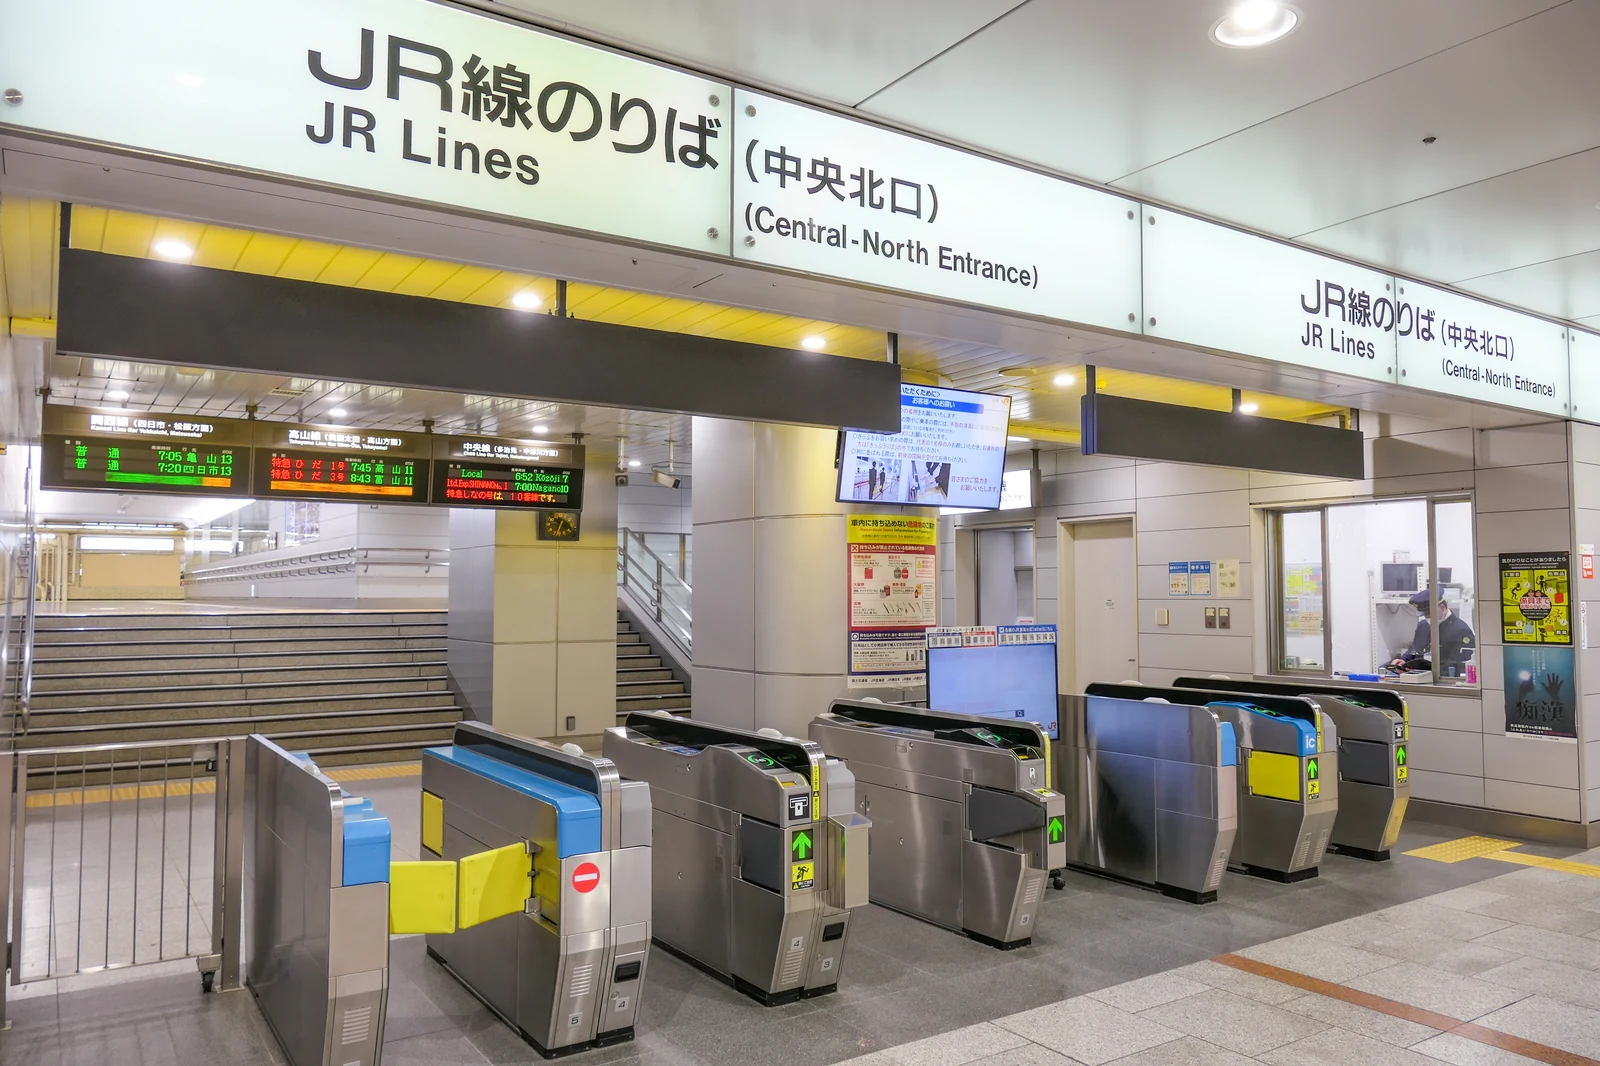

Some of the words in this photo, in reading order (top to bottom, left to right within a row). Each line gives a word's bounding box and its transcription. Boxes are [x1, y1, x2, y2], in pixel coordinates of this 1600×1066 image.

[308, 27, 723, 170] JR線のりば
[306, 101, 377, 153] JR
[402, 118, 540, 186] Lines
[745, 139, 938, 224] (中央北口)
[745, 202, 929, 266] (Central-North
[939, 245, 1038, 290] Entrance)
[1301, 279, 1436, 342] JR線のりば
[1441, 319, 1514, 361] (中央北口)
[1301, 322, 1323, 349] JR
[1330, 327, 1375, 359] Lines
[1514, 375, 1556, 398] Entrance)
[158, 450, 182, 462] 7:05
[221, 455, 232, 465] 13
[158, 463, 182, 474] 7:20
[220, 466, 232, 476] 13
[351, 462, 372, 472] 7:45
[405, 465, 414, 474] 11
[351, 473, 371, 484] 8:43
[404, 476, 413, 486] 11
[461, 469, 483, 478] Local
[515, 471, 533, 481] 6:52
[562, 474, 568, 483] 7
[515, 482, 532, 491] 7:00
[561, 484, 569, 493] 10
[1515, 700, 1564, 722] 痴漢
[1048, 722, 1057, 730] JR
[1023, 916, 1028, 924] 3
[793, 939, 800, 947] 4
[824, 960, 831, 969] 3
[618, 1000, 626, 1009] 4
[571, 1016, 579, 1026] 5
